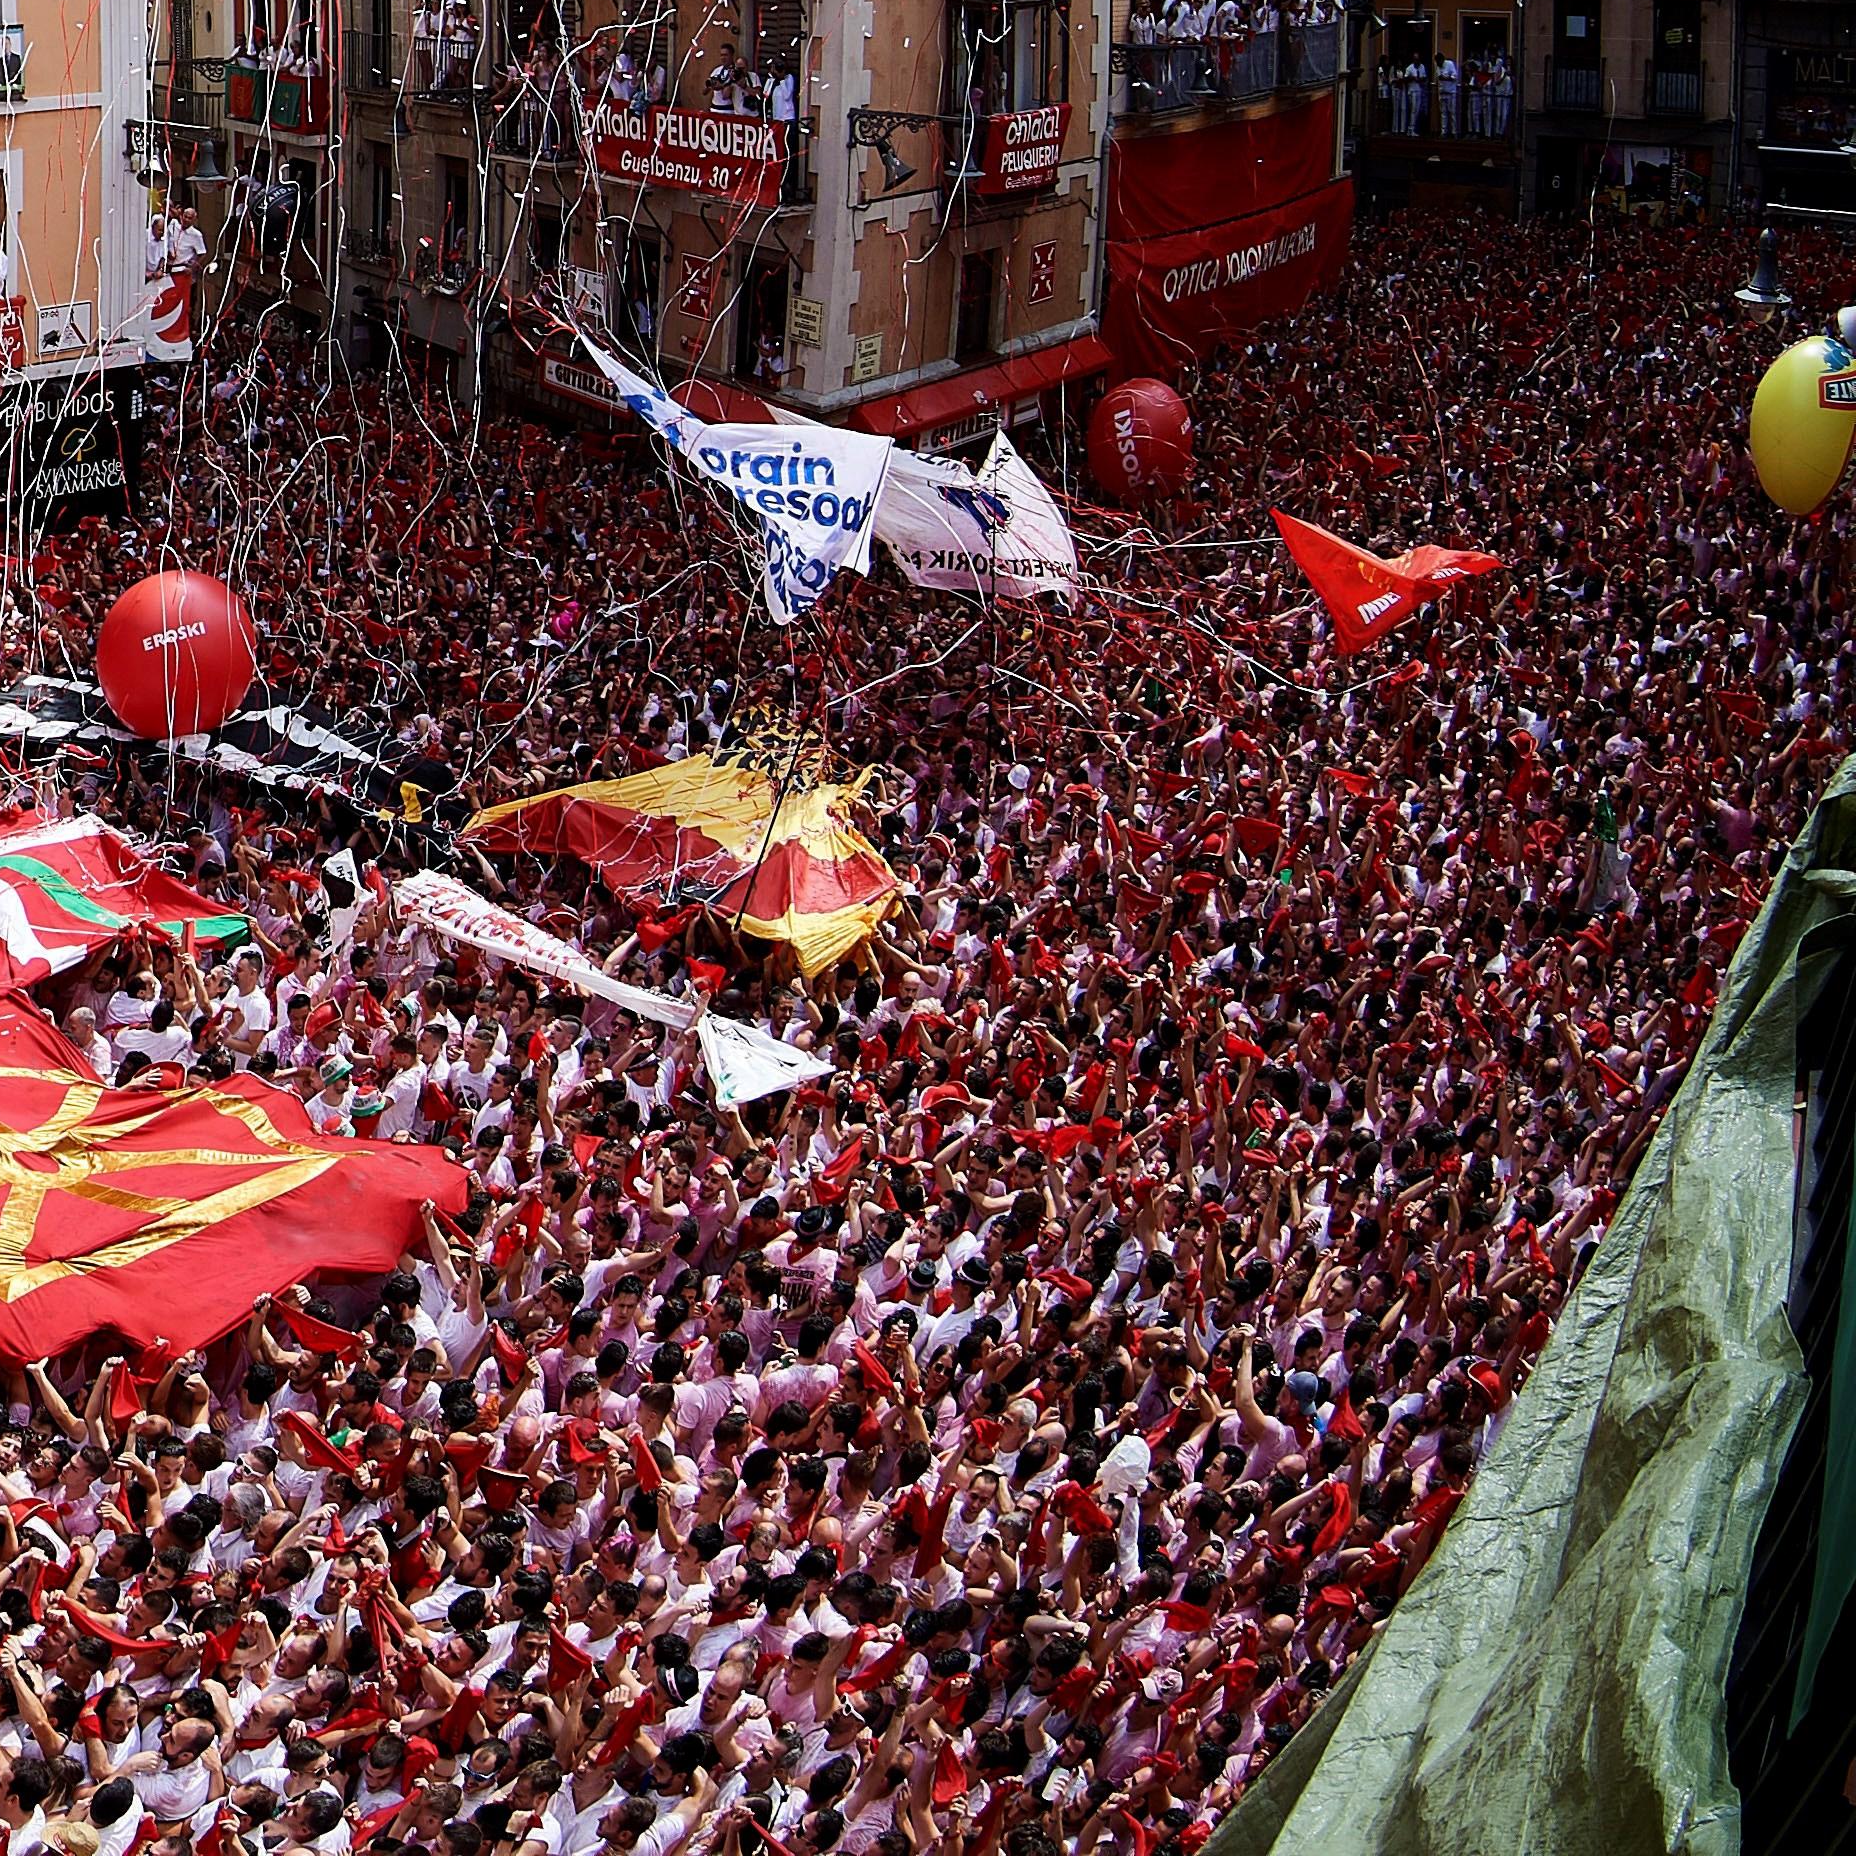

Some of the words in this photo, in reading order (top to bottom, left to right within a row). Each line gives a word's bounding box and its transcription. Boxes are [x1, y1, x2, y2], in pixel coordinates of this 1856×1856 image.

[708, 165, 730, 190] 30
[1163, 258, 1220, 303] OPTICA
[698, 441, 835, 487] orain
[1113, 408, 1145, 489] ROSKI
[35, 471, 127, 500] SALAMANCA
[141, 620, 207, 653] EROSKI
